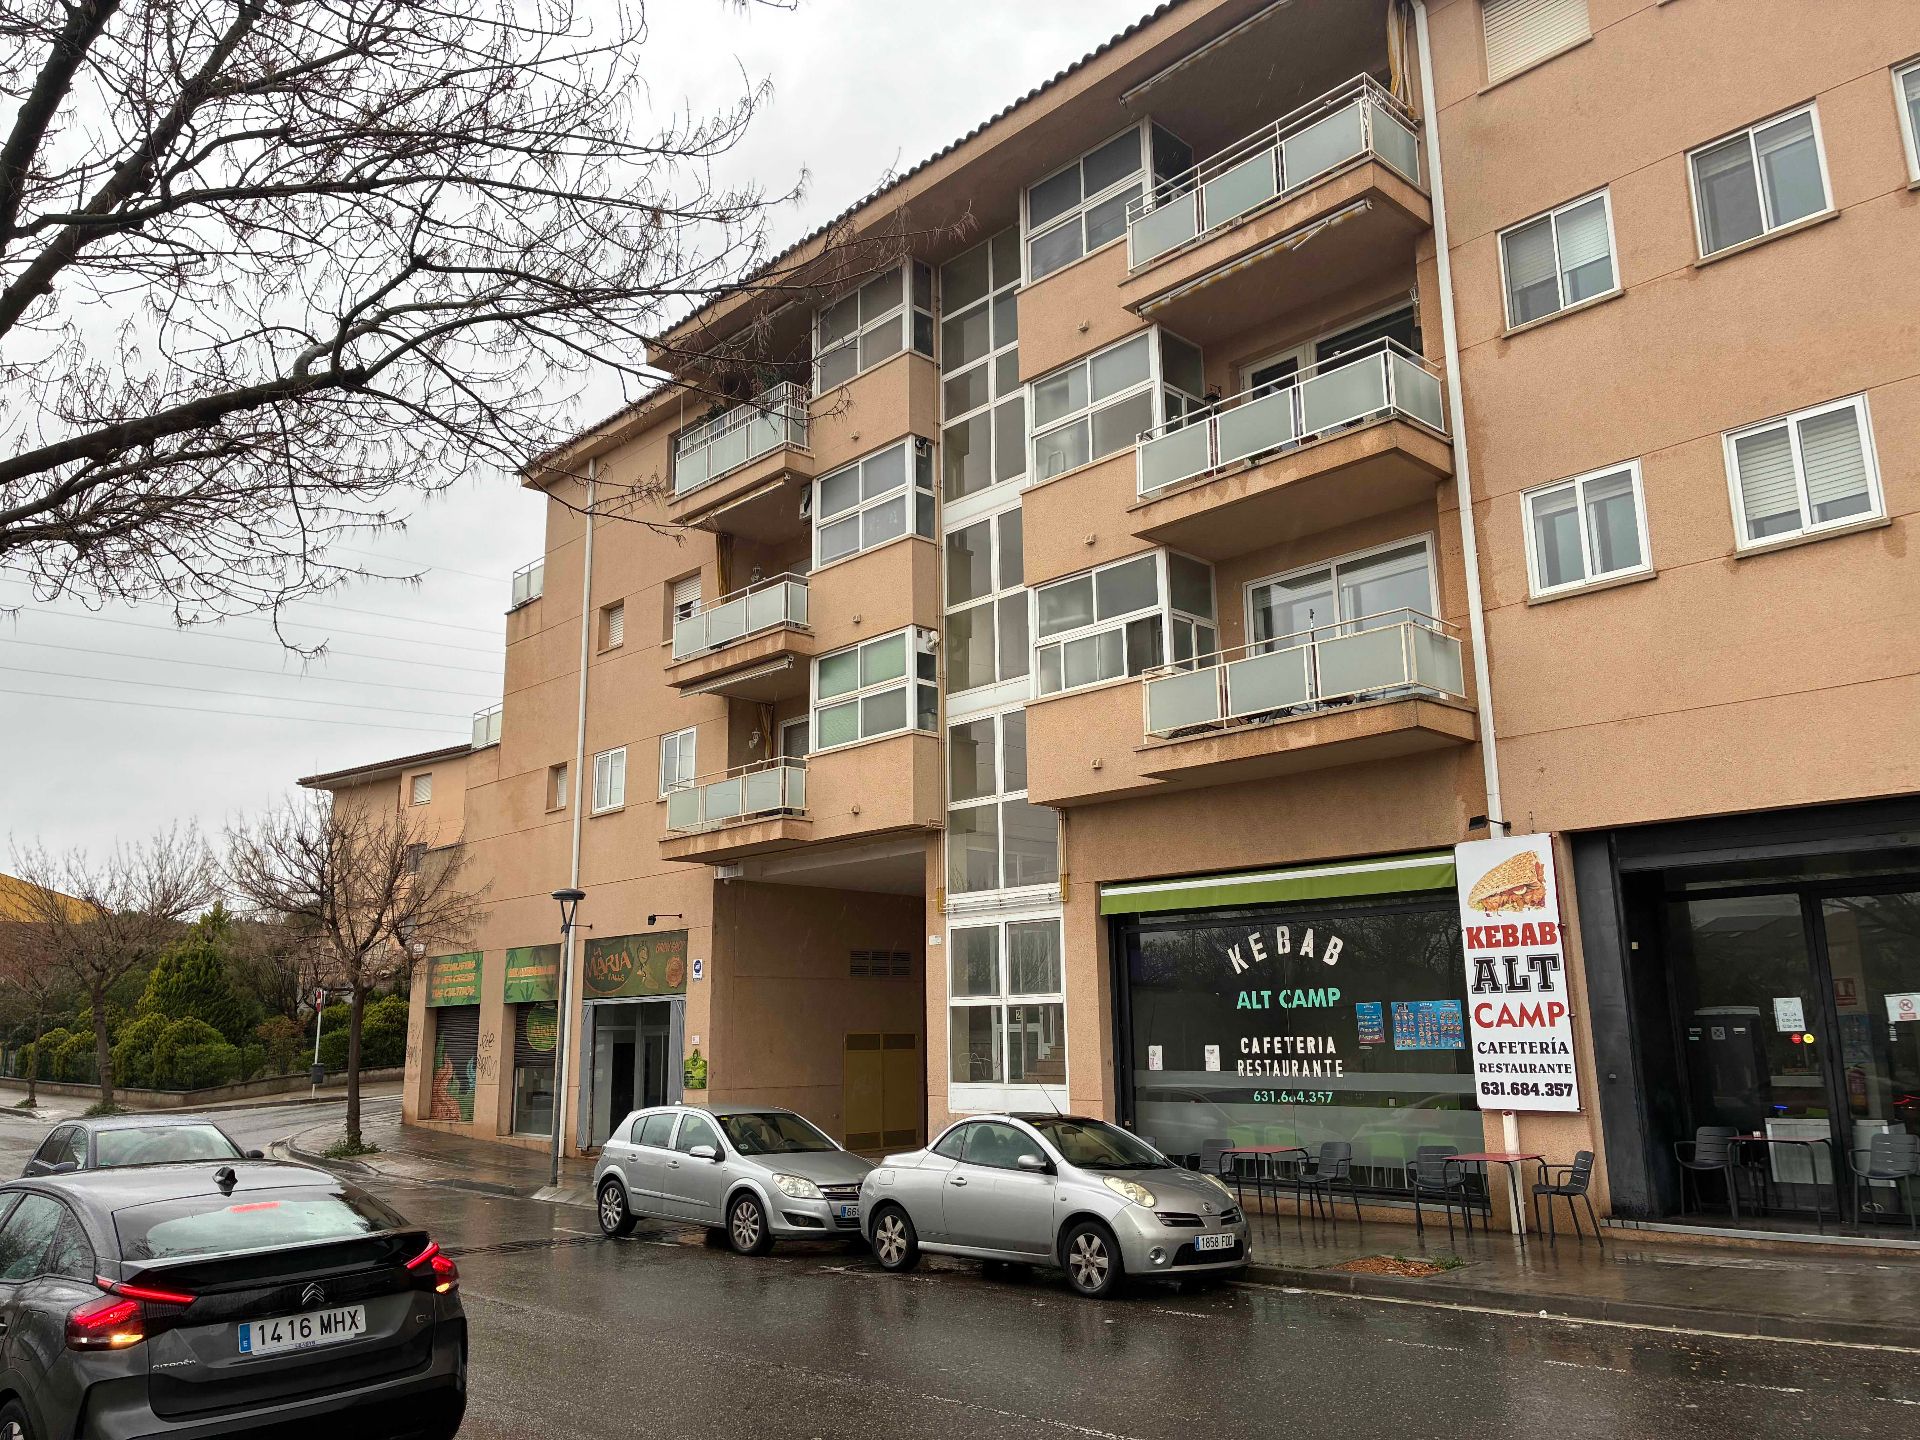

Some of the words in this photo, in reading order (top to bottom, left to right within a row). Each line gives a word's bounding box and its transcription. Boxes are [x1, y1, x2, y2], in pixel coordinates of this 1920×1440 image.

[1465, 921, 1558, 950] KEBAB
[1227, 924, 1344, 975] KEBAB
[1471, 952, 1561, 995] ALT
[1236, 990, 1272, 1010] ALT
[1278, 987, 1341, 1009] CAMP
[1474, 1001, 1566, 1029] CAMP
[1240, 1036, 1337, 1054] CAFETERIA
[1477, 1036, 1570, 1055] CAFETERÍA
[1237, 1059, 1344, 1078] RESTAURANTE
[1478, 1062, 1572, 1074] RESTAURANTE
[1480, 1081, 1574, 1097] 631.684.357
[1201, 1236, 1219, 1249] 1858
[258, 1317, 312, 1346] 1416
[319, 1309, 360, 1336] MHX
